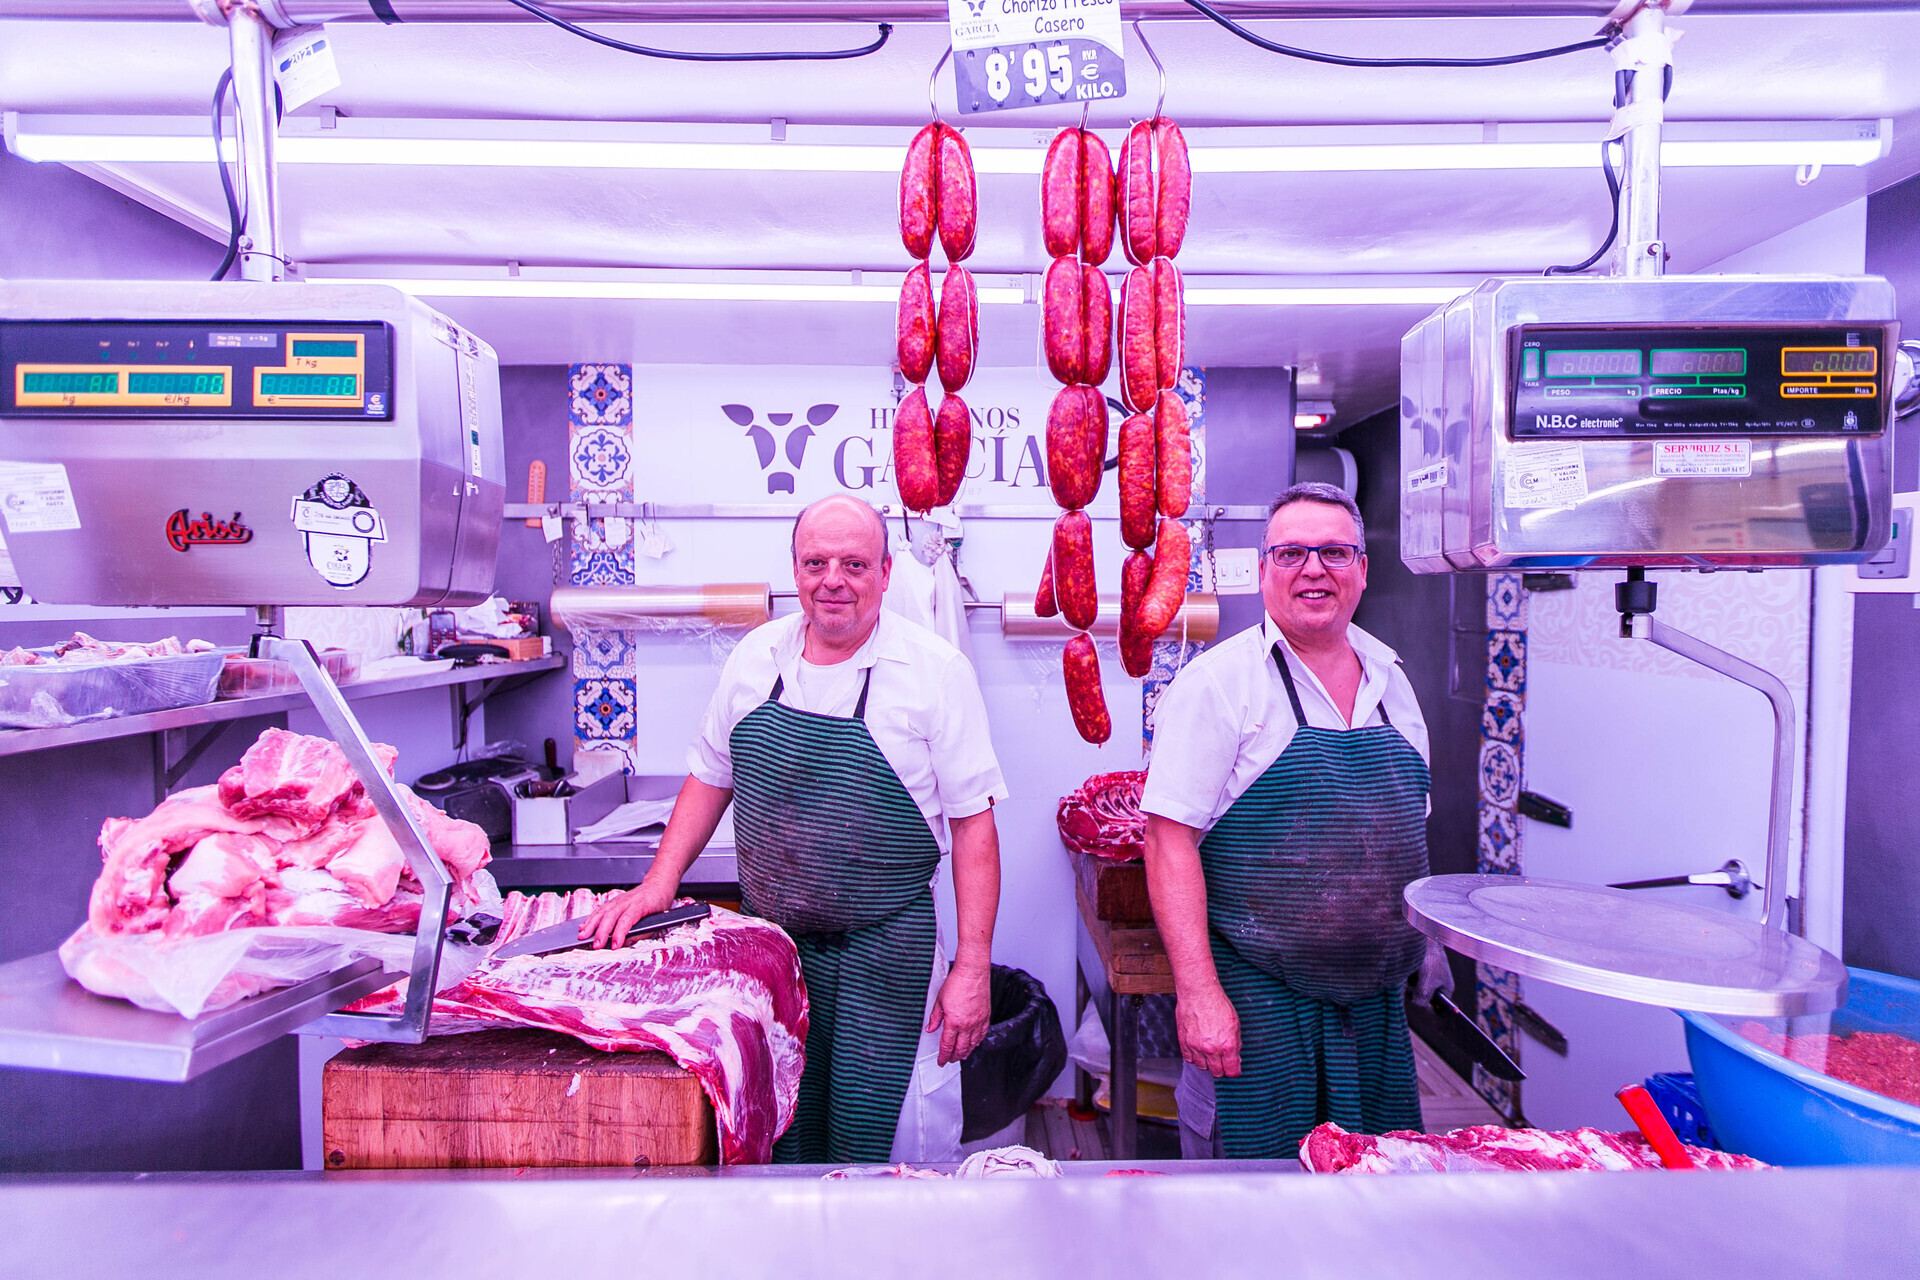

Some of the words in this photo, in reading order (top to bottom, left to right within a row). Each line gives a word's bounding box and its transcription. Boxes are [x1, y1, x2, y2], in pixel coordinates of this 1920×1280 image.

[1002, 0, 1057, 14] Chorizo
[1035, 16, 1085, 33] Casero
[288, 44, 315, 66] 2021
[1076, 81, 1118, 99] KILO.
[1627, 388, 1636, 396] kg
[1655, 387, 1682, 395] PRECIO
[62, 394, 75, 405] kg
[870, 407, 1020, 430] HNOS
[1664, 444, 1721, 454] SERVIRUIZ
[1723, 444, 1743, 453] S.L.
[833, 428, 1051, 490] GÍA
[1550, 464, 1579, 472] CONFORME
